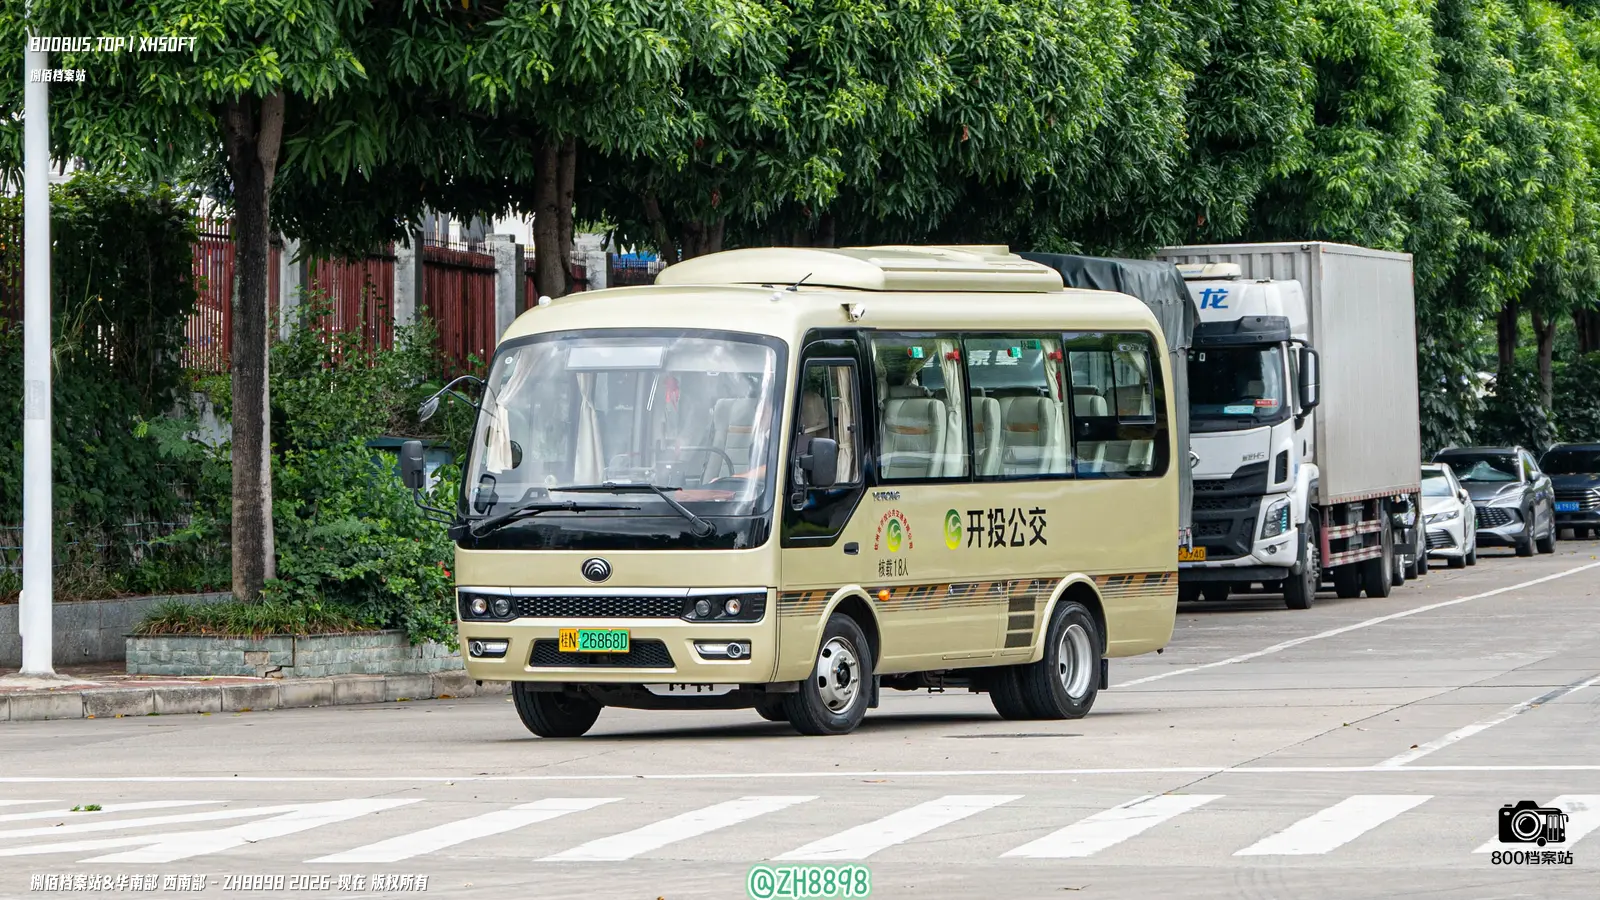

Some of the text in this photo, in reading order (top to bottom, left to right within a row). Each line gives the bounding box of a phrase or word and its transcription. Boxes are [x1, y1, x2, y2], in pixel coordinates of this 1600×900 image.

[1199, 288, 1229, 309] 龙
[966, 506, 1048, 548] 开投公交
[878, 558, 909, 577] 核载18人
